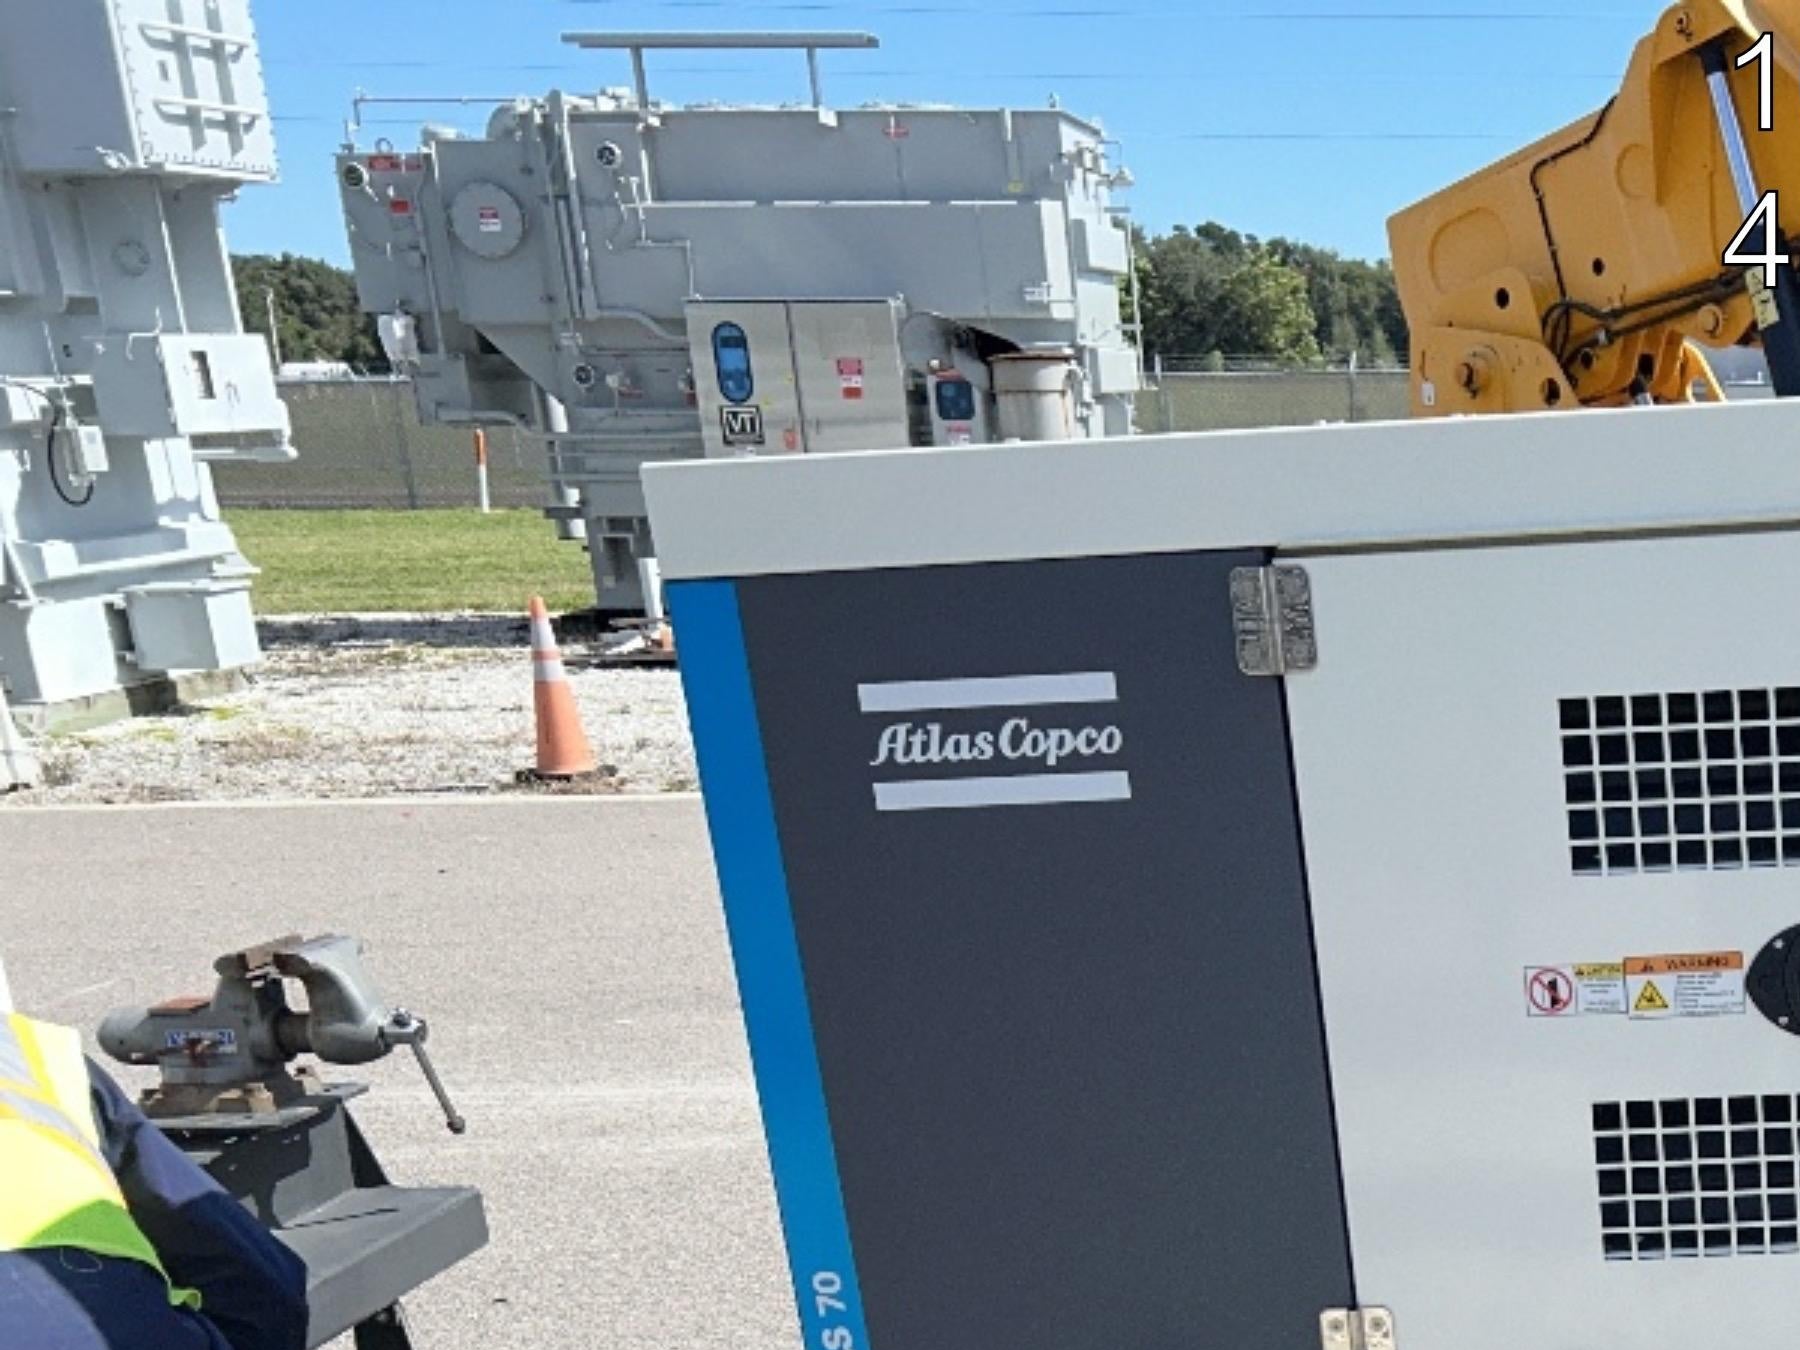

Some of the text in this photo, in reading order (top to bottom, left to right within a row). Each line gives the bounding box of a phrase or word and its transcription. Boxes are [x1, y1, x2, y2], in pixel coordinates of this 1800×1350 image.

[869, 717, 1123, 766] Atlas Copco
[811, 1270, 848, 1319] 70
